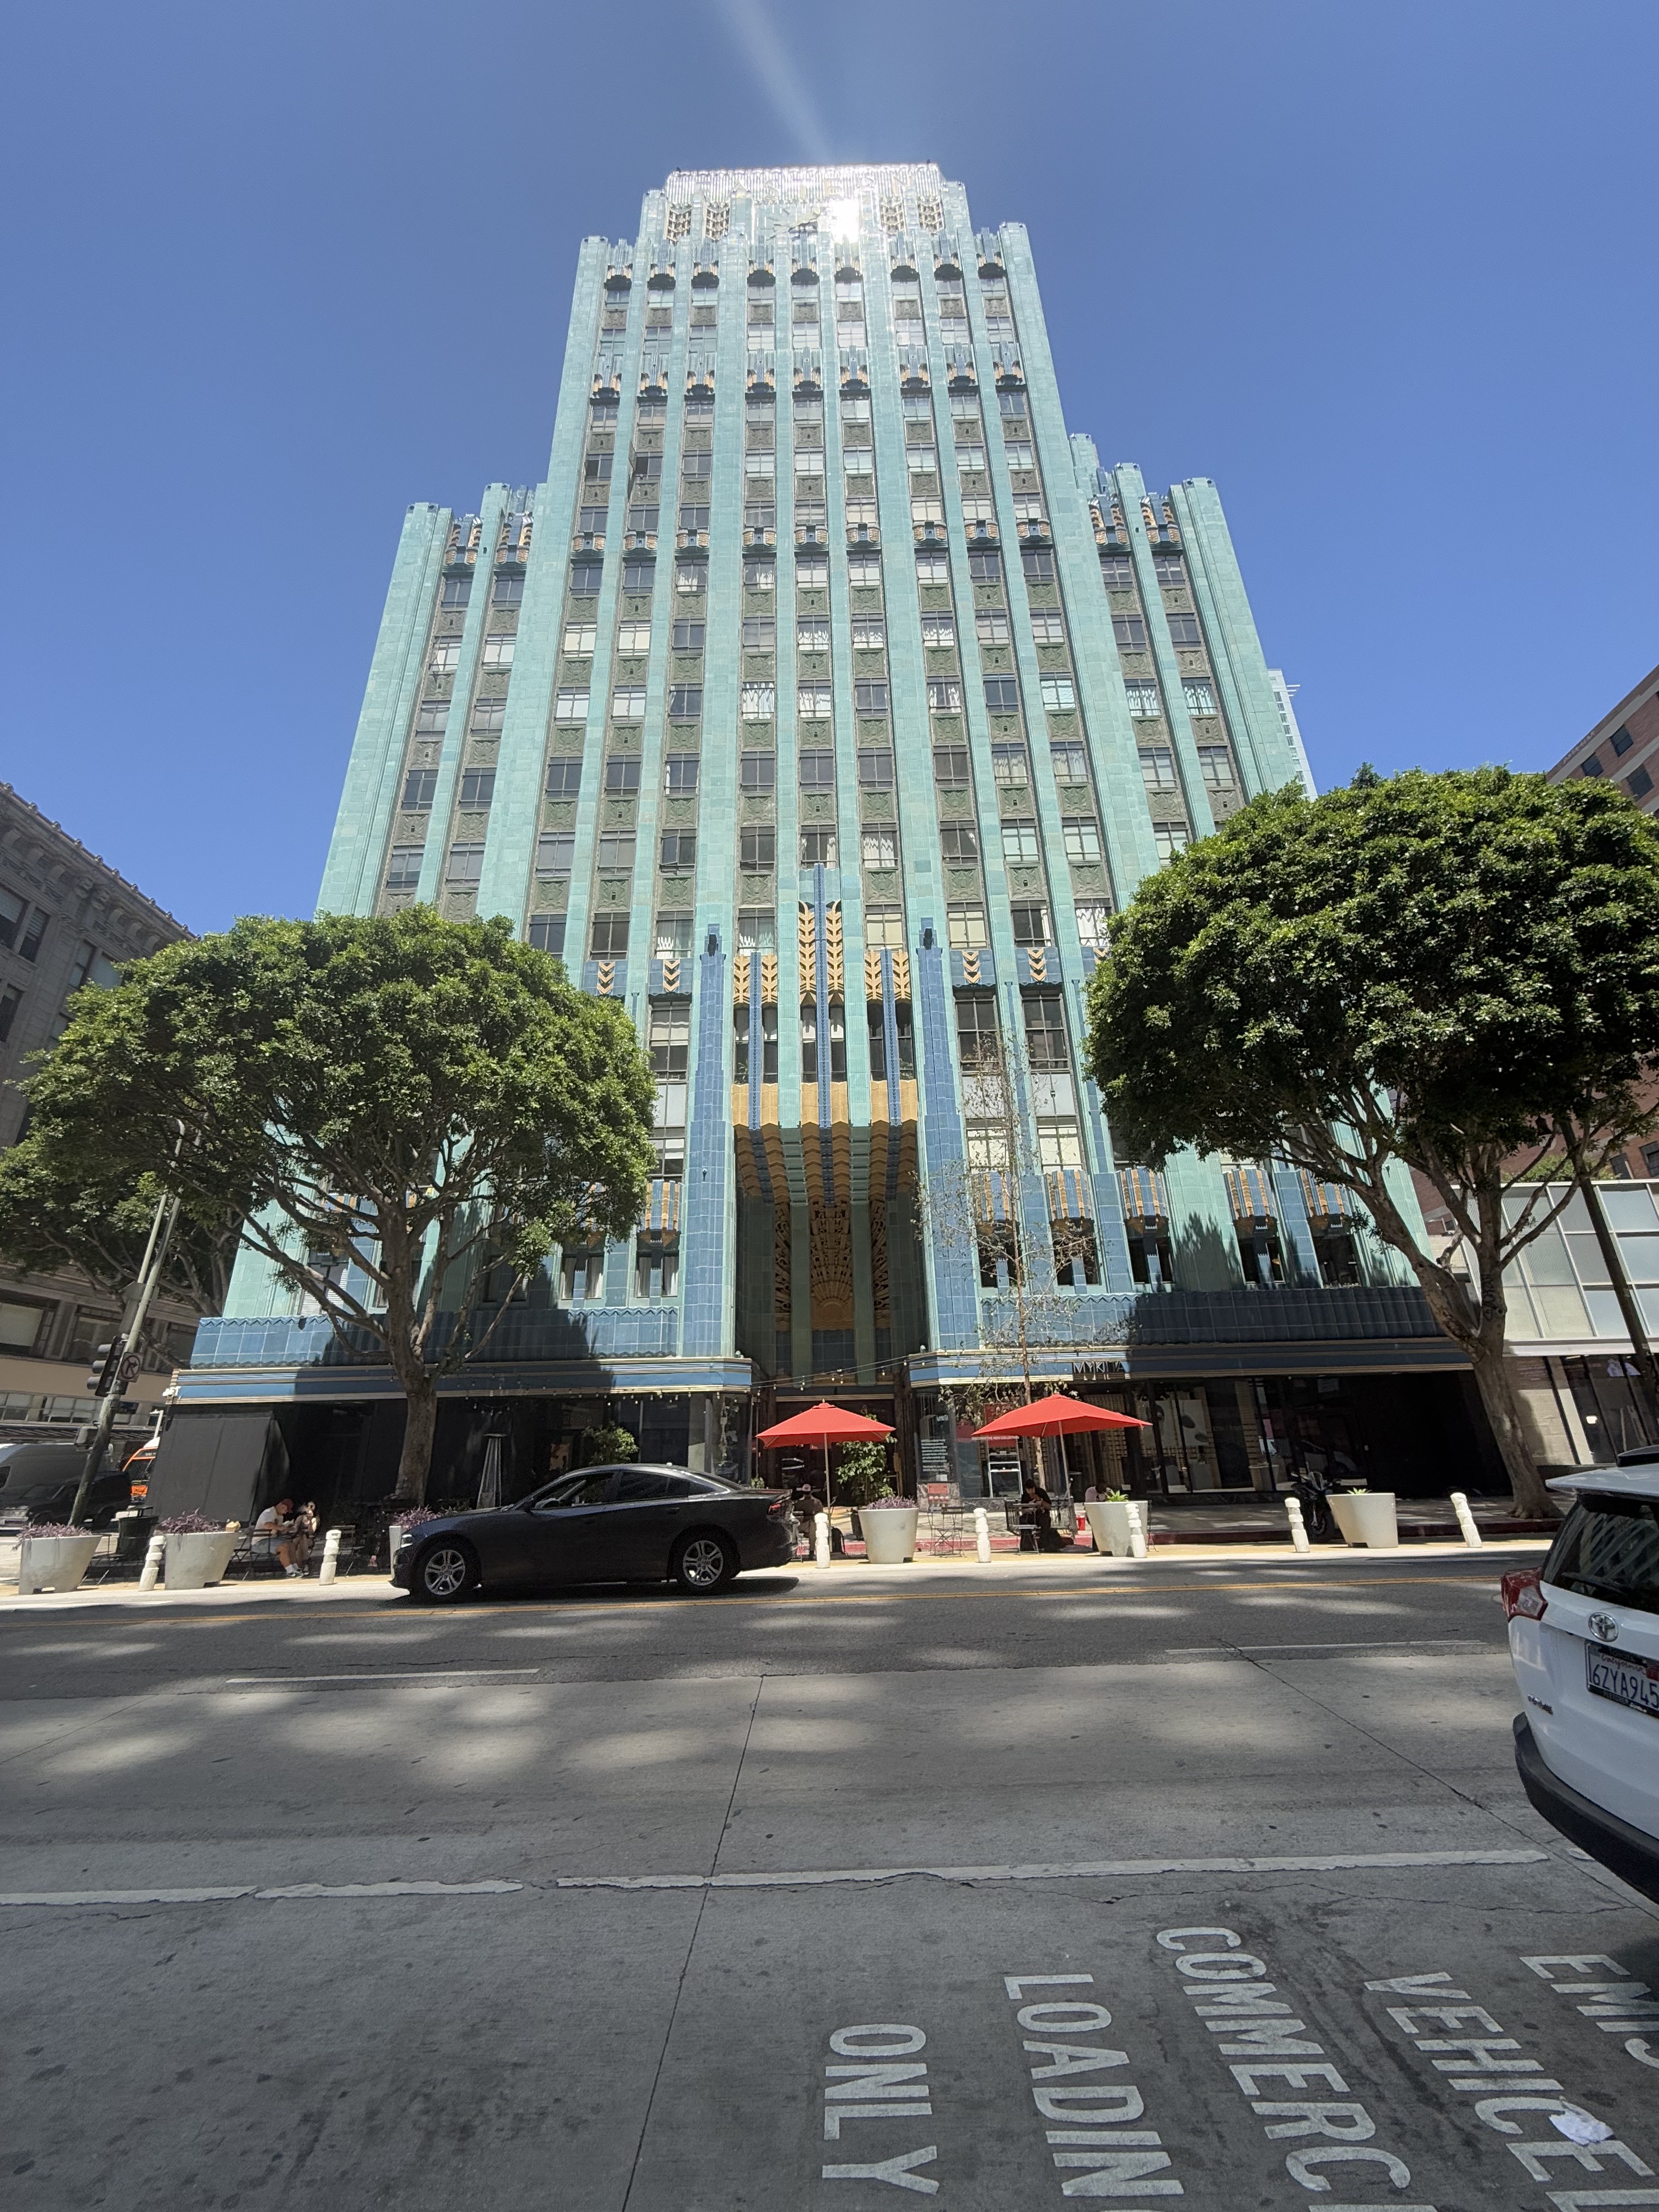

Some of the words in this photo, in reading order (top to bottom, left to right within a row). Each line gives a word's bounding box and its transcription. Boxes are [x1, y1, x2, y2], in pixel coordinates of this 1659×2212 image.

[1593, 1664, 1659, 1709] 6ZYA945
[822, 2023, 940, 2194] ONLY
[1004, 1974, 1184, 2212] LOADIN
